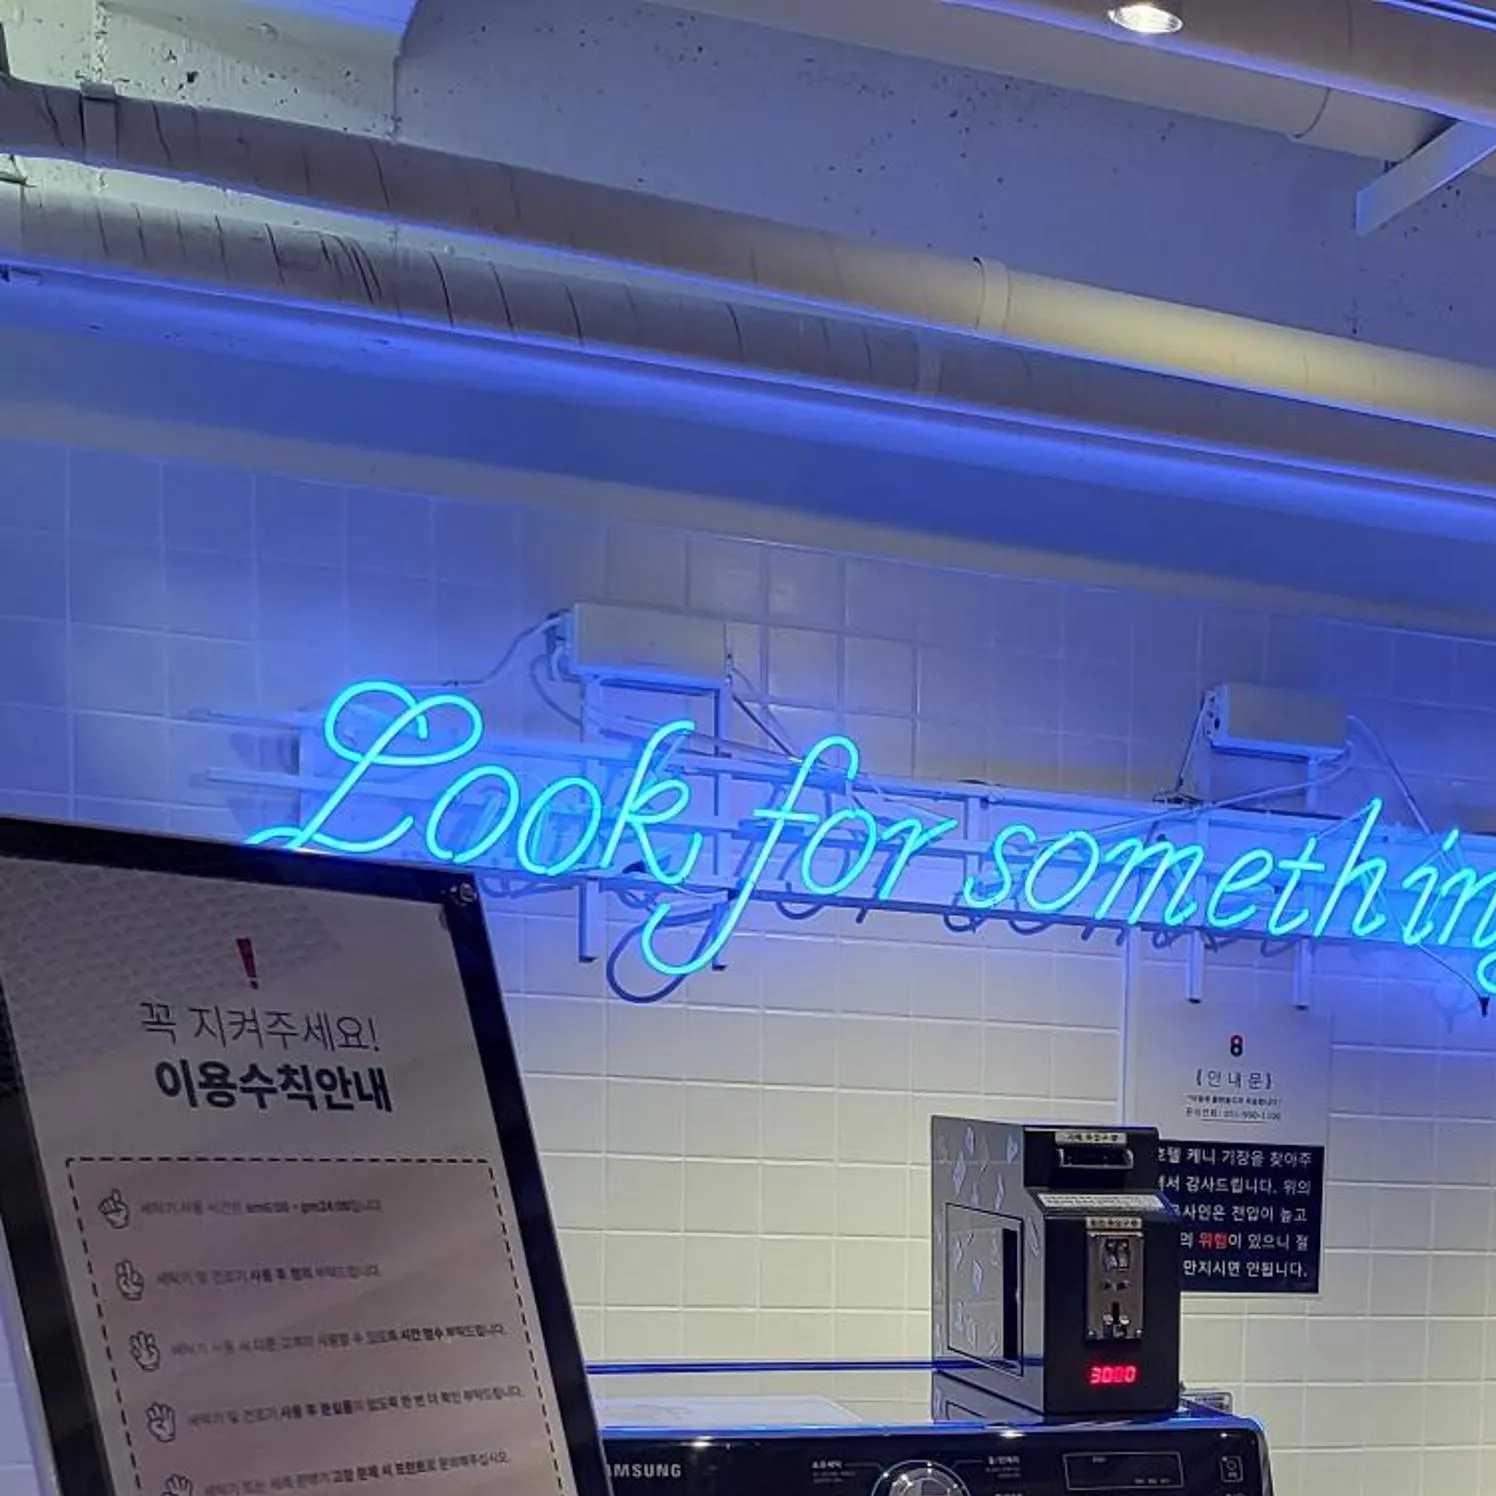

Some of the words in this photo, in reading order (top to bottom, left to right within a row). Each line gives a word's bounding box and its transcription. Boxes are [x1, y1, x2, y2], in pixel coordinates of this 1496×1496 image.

[244, 680, 703, 888] Look
[641, 734, 958, 975] for
[139, 1001, 177, 1045] 꼭
[187, 1004, 381, 1052] 지켜주세요!
[154, 1058, 393, 1113] 이용수칙안내
[1222, 1149, 1265, 1168] 기장을
[1185, 1175, 1278, 1195] 감사드립니다.
[1231, 1203, 1274, 1222] 전압이
[1247, 1233, 1290, 1250] 있으니
[1183, 1259, 1240, 1278] 만지시면
[1246, 1260, 1308, 1278] 안됩니다.
[606, 1463, 682, 1478] MSUNG
